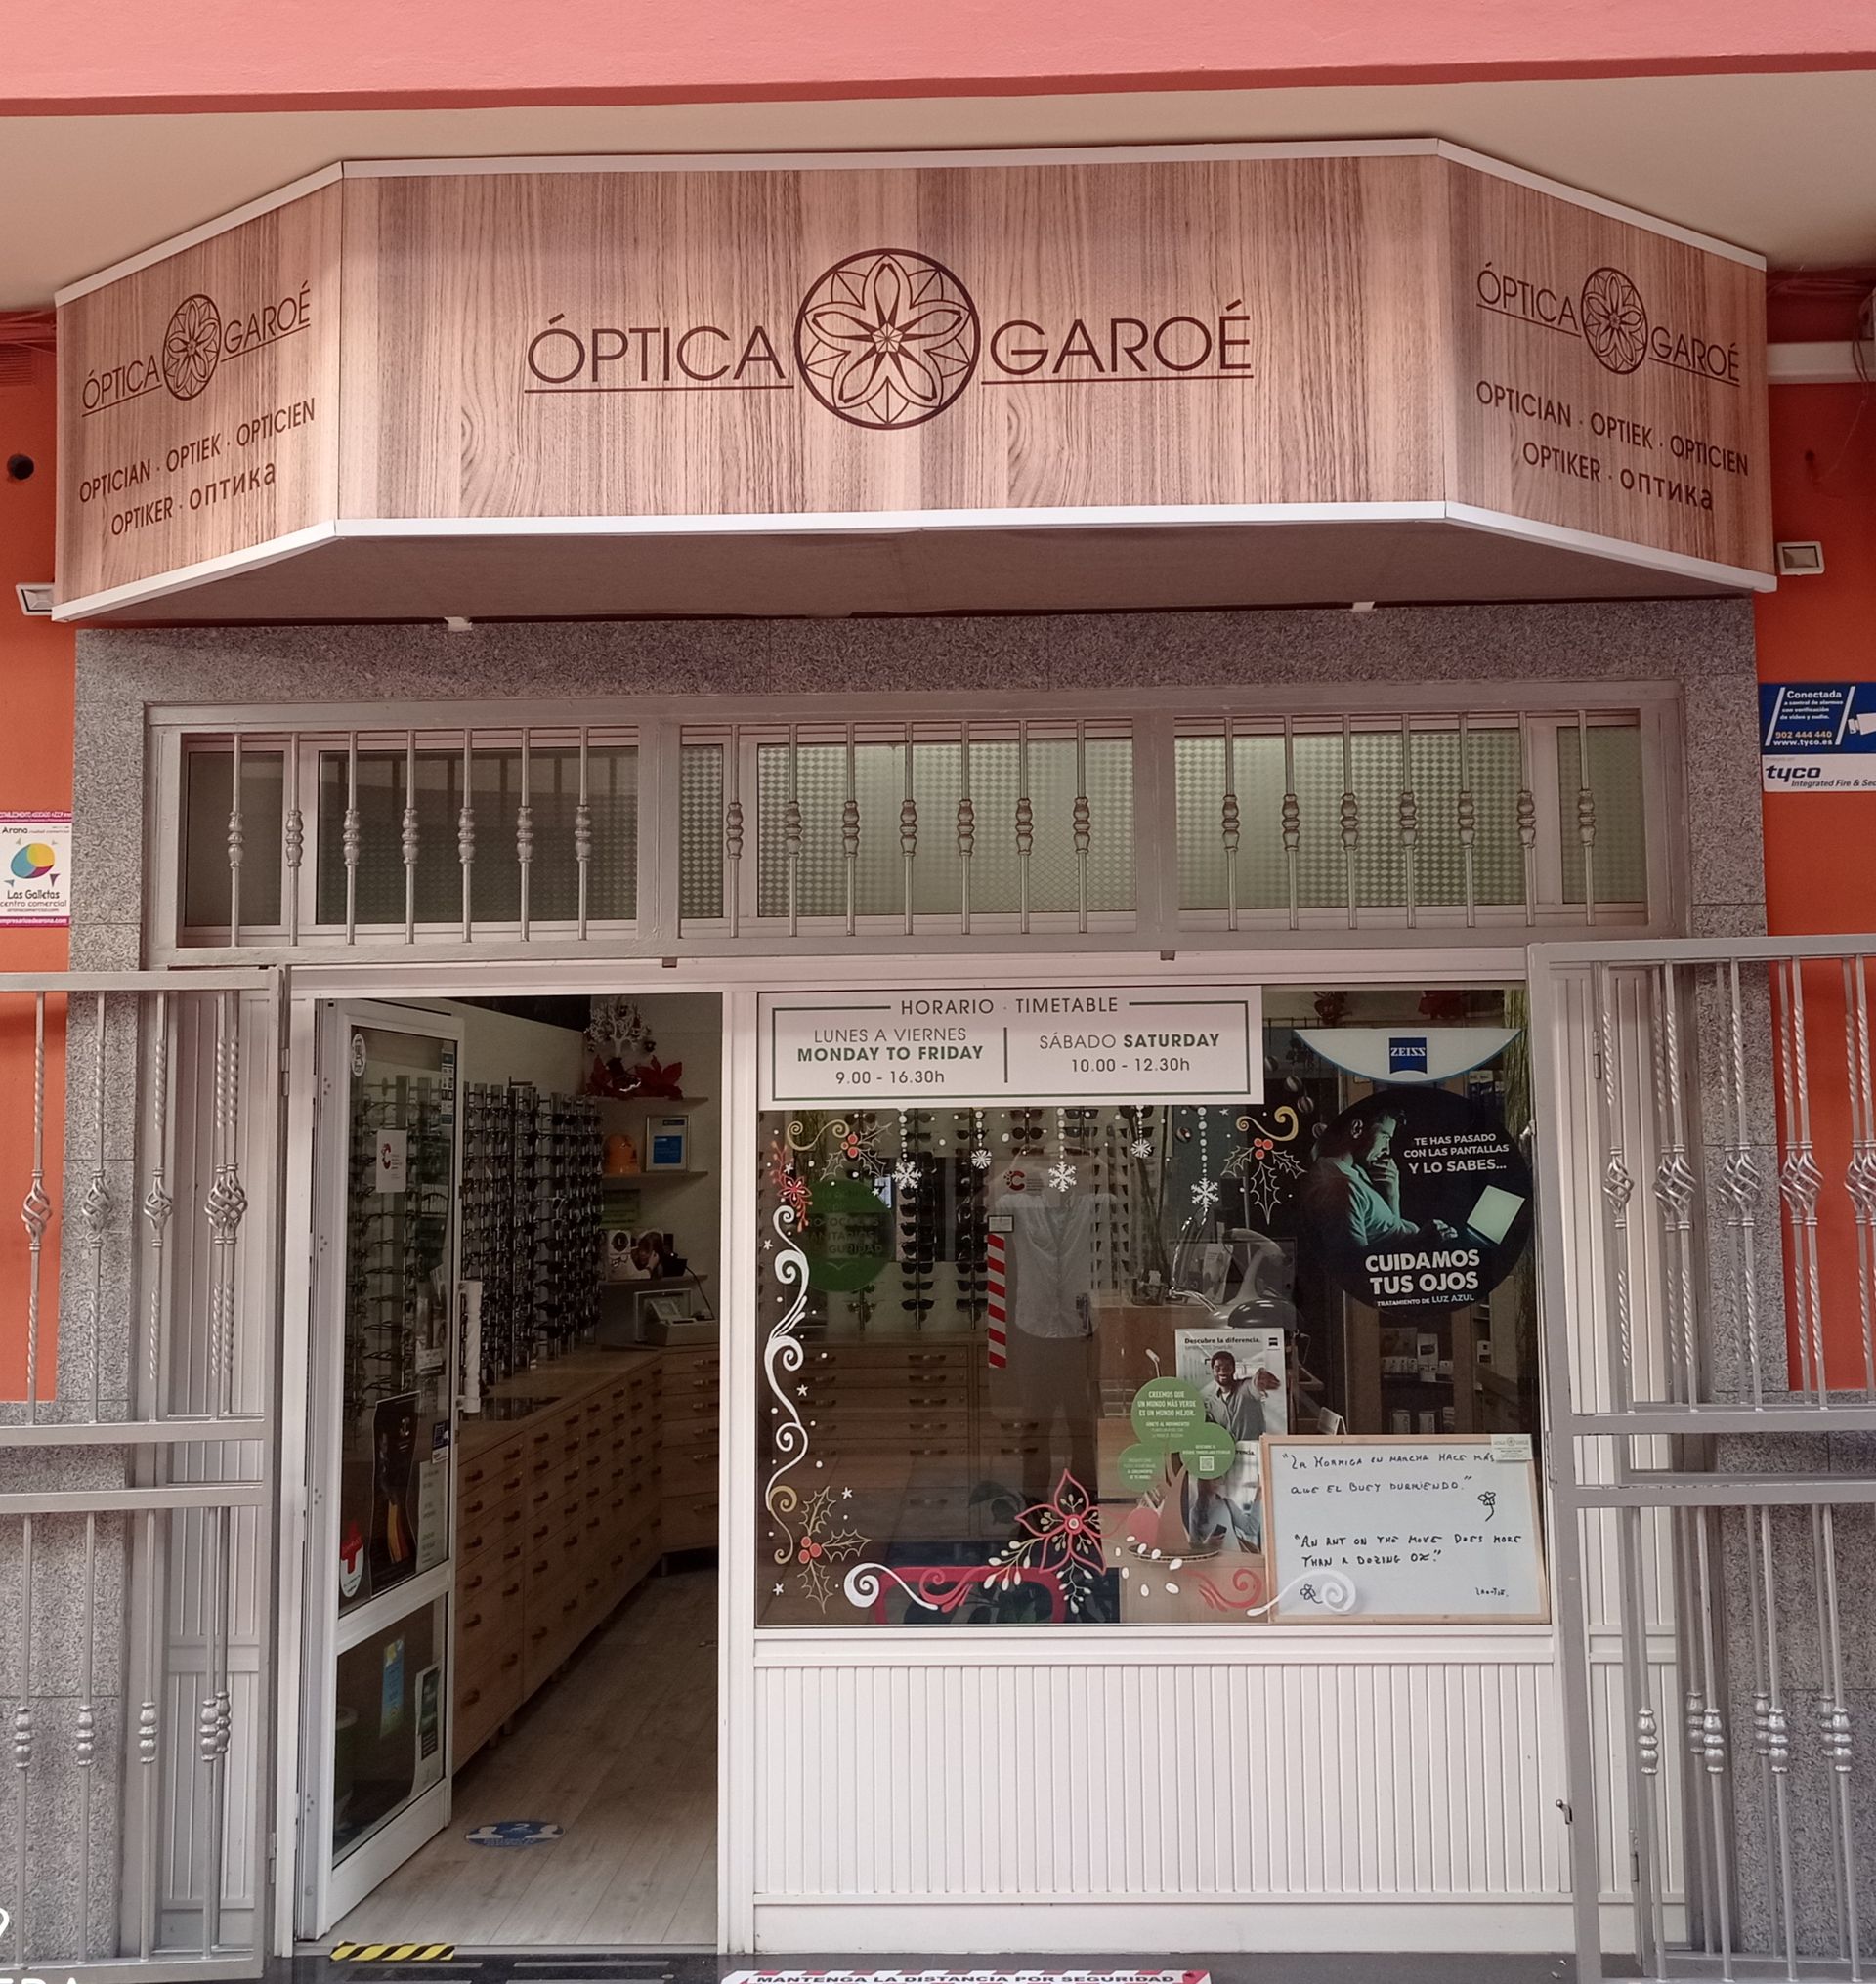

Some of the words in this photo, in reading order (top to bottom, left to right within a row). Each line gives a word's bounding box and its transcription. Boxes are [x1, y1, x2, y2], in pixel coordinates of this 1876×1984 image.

[1476, 262, 1577, 332] ÓPTICA
[1651, 326, 1740, 382] GAROÉ
[82, 355, 160, 410] ÓPTICA
[224, 280, 311, 354] GAROÉ
[527, 313, 786, 384] ÓPTICA
[989, 298, 1251, 376] GAROÉ
[1476, 380, 1571, 428] OPTICIAN
[1591, 412, 1653, 450] OPTIEK
[1670, 435, 1748, 476] OPTICIEN
[79, 458, 151, 503] OPTICIAN
[166, 433, 221, 473] OPTIEK
[236, 397, 316, 447] OPTICIEN
[1523, 442, 1601, 483] OPTIKER
[111, 496, 174, 535] OPTIKER
[1786, 690, 1842, 698] Conectada
[1766, 765, 1821, 781] tyco
[1791, 780, 1834, 788] Integrated
[7, 889, 23, 900] Las
[28, 899, 67, 908] comercial
[901, 998, 994, 1016] HORARIO
[1016, 996, 1119, 1015] TIMETABLE
[814, 1028, 869, 1043] LUNES
[874, 1028, 888, 1042] A
[894, 1027, 967, 1042] VIERNES
[1039, 1031, 1117, 1050] SÁBADO
[1123, 1033, 1220, 1048] SATURDAY
[796, 1046, 879, 1063] MONDAY
[887, 1045, 911, 1061] TO
[918, 1044, 984, 1061] FRIDAY
[1390, 1047, 1427, 1057] ZEISS
[1072, 1058, 1117, 1073] 10.00
[1134, 1057, 1190, 1072] 12.30h
[835, 1071, 872, 1085] 9.00
[889, 1070, 945, 1084] 16.30h
[1414, 1137, 1428, 1146] TE
[1429, 1136, 1452, 1145] HAS
[1454, 1133, 1496, 1144] PASADO
[1403, 1149, 1426, 1158] CON
[1428, 1147, 1448, 1157] LAS
[1450, 1144, 1510, 1156] PANTALLAS
[1408, 1162, 1420, 1174] Y
[1423, 1161, 1443, 1173] LO
[1446, 1159, 1507, 1172] SABES...
[1365, 1249, 1480, 1273] CUIDAMOS
[1369, 1275, 1414, 1295] TUS
[1419, 1271, 1479, 1292] OJOS
[1377, 1298, 1421, 1307] TRATAMIENTO
[1431, 1295, 1449, 1304] LUZ
[1451, 1293, 1475, 1302] AZUL
